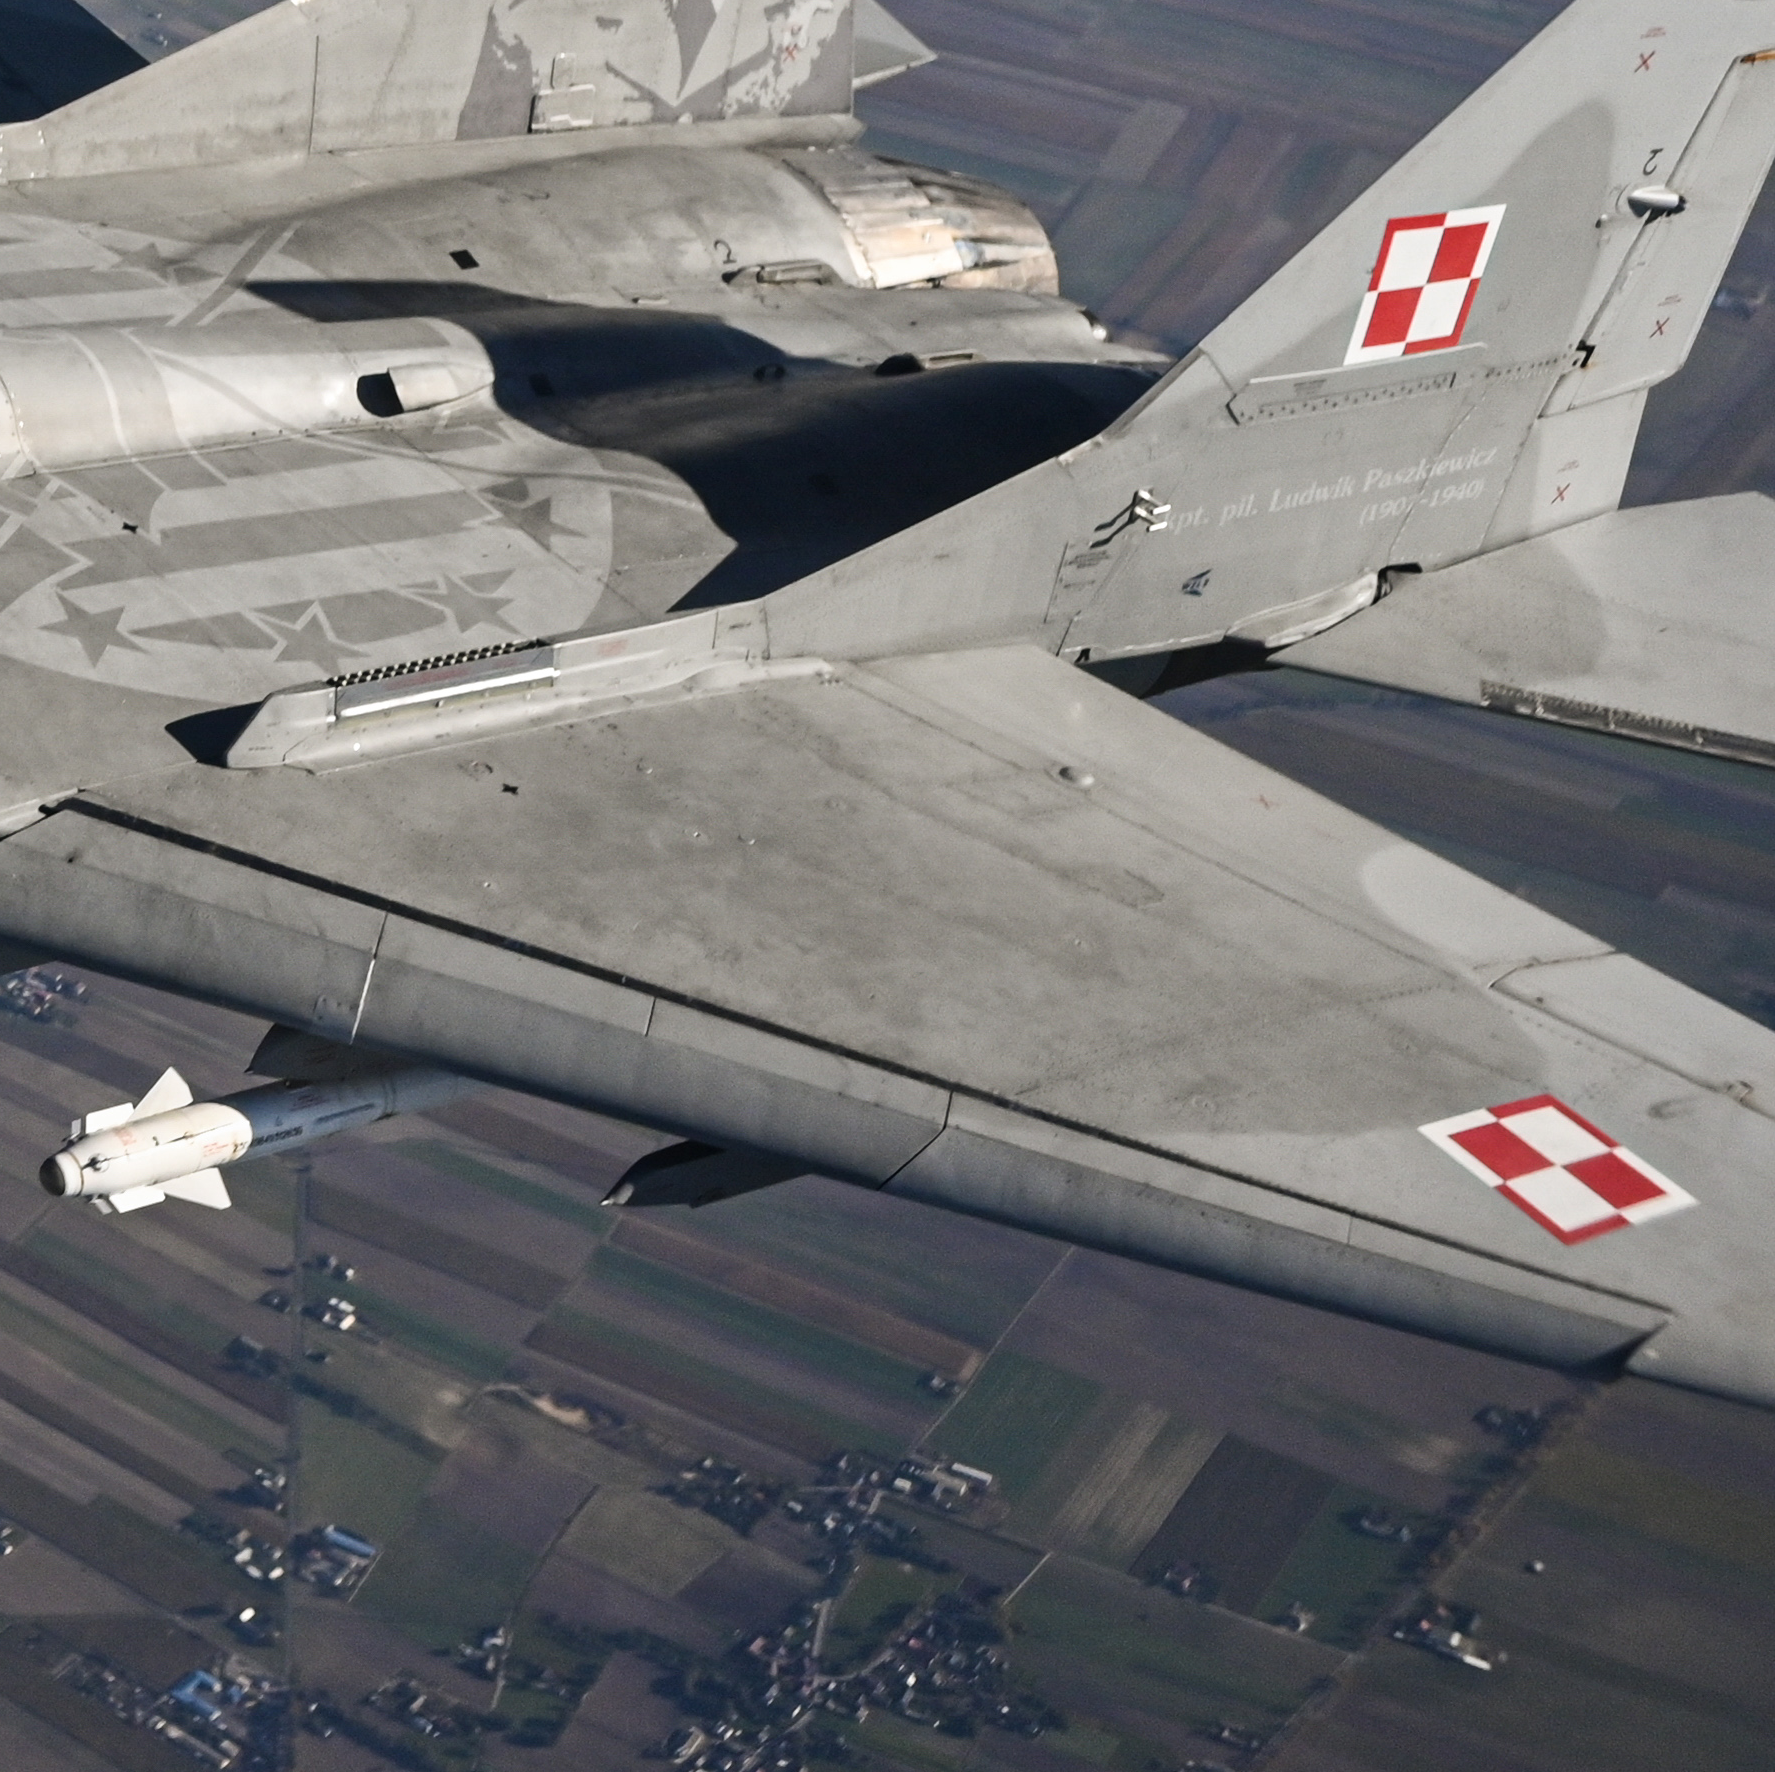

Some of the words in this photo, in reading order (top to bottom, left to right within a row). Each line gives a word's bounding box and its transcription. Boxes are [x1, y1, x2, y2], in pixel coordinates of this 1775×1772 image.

[1219, 494, 1258, 527] pil.
[1268, 476, 1353, 513] Ludwik
[1363, 446, 1498, 493] Paszkiewicz
